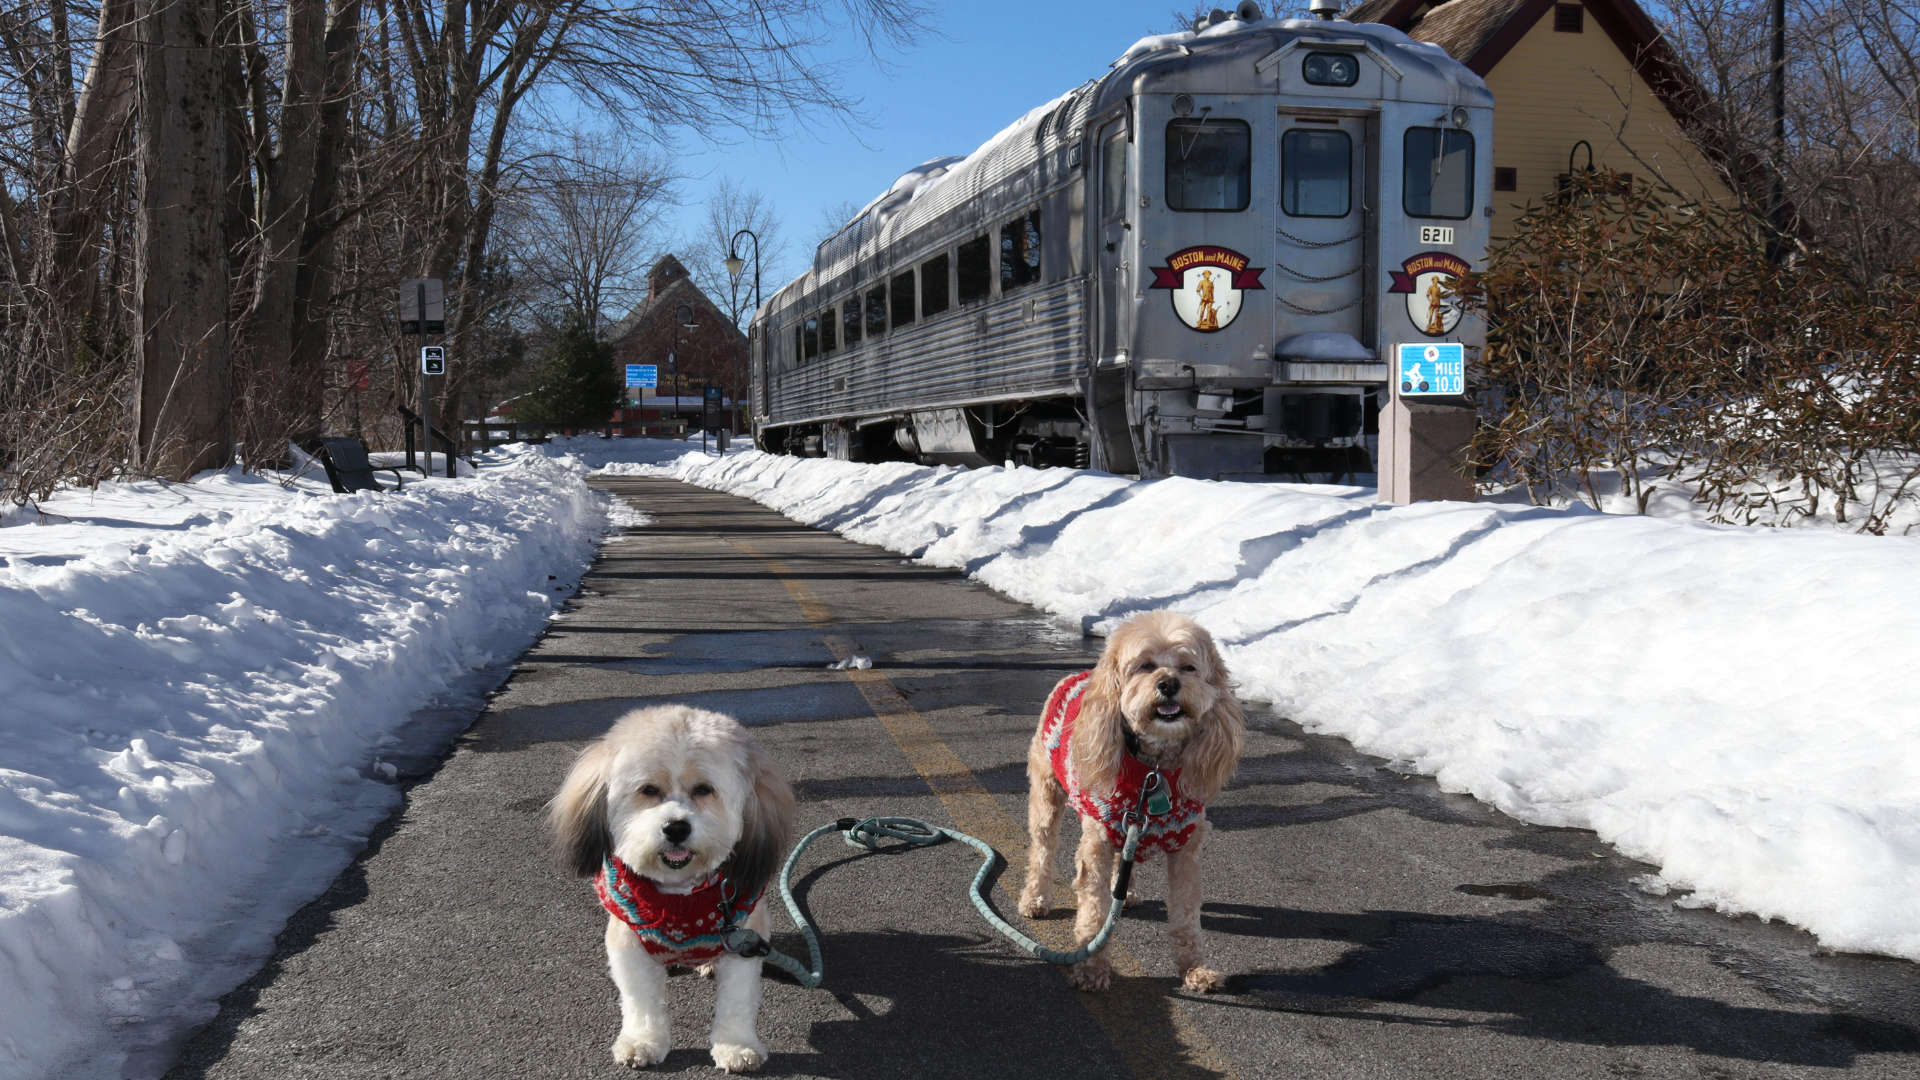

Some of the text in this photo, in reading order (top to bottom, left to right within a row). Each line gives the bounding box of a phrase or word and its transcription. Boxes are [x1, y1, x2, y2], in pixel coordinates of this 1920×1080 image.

[1423, 228, 1452, 242] 6211
[1171, 251, 1204, 270] BOSTON
[1217, 252, 1245, 270] MAINE
[1407, 257, 1465, 277] BOSTON and MAINE
[1435, 362, 1460, 375] MILE
[1435, 376, 1460, 392] 10.0
